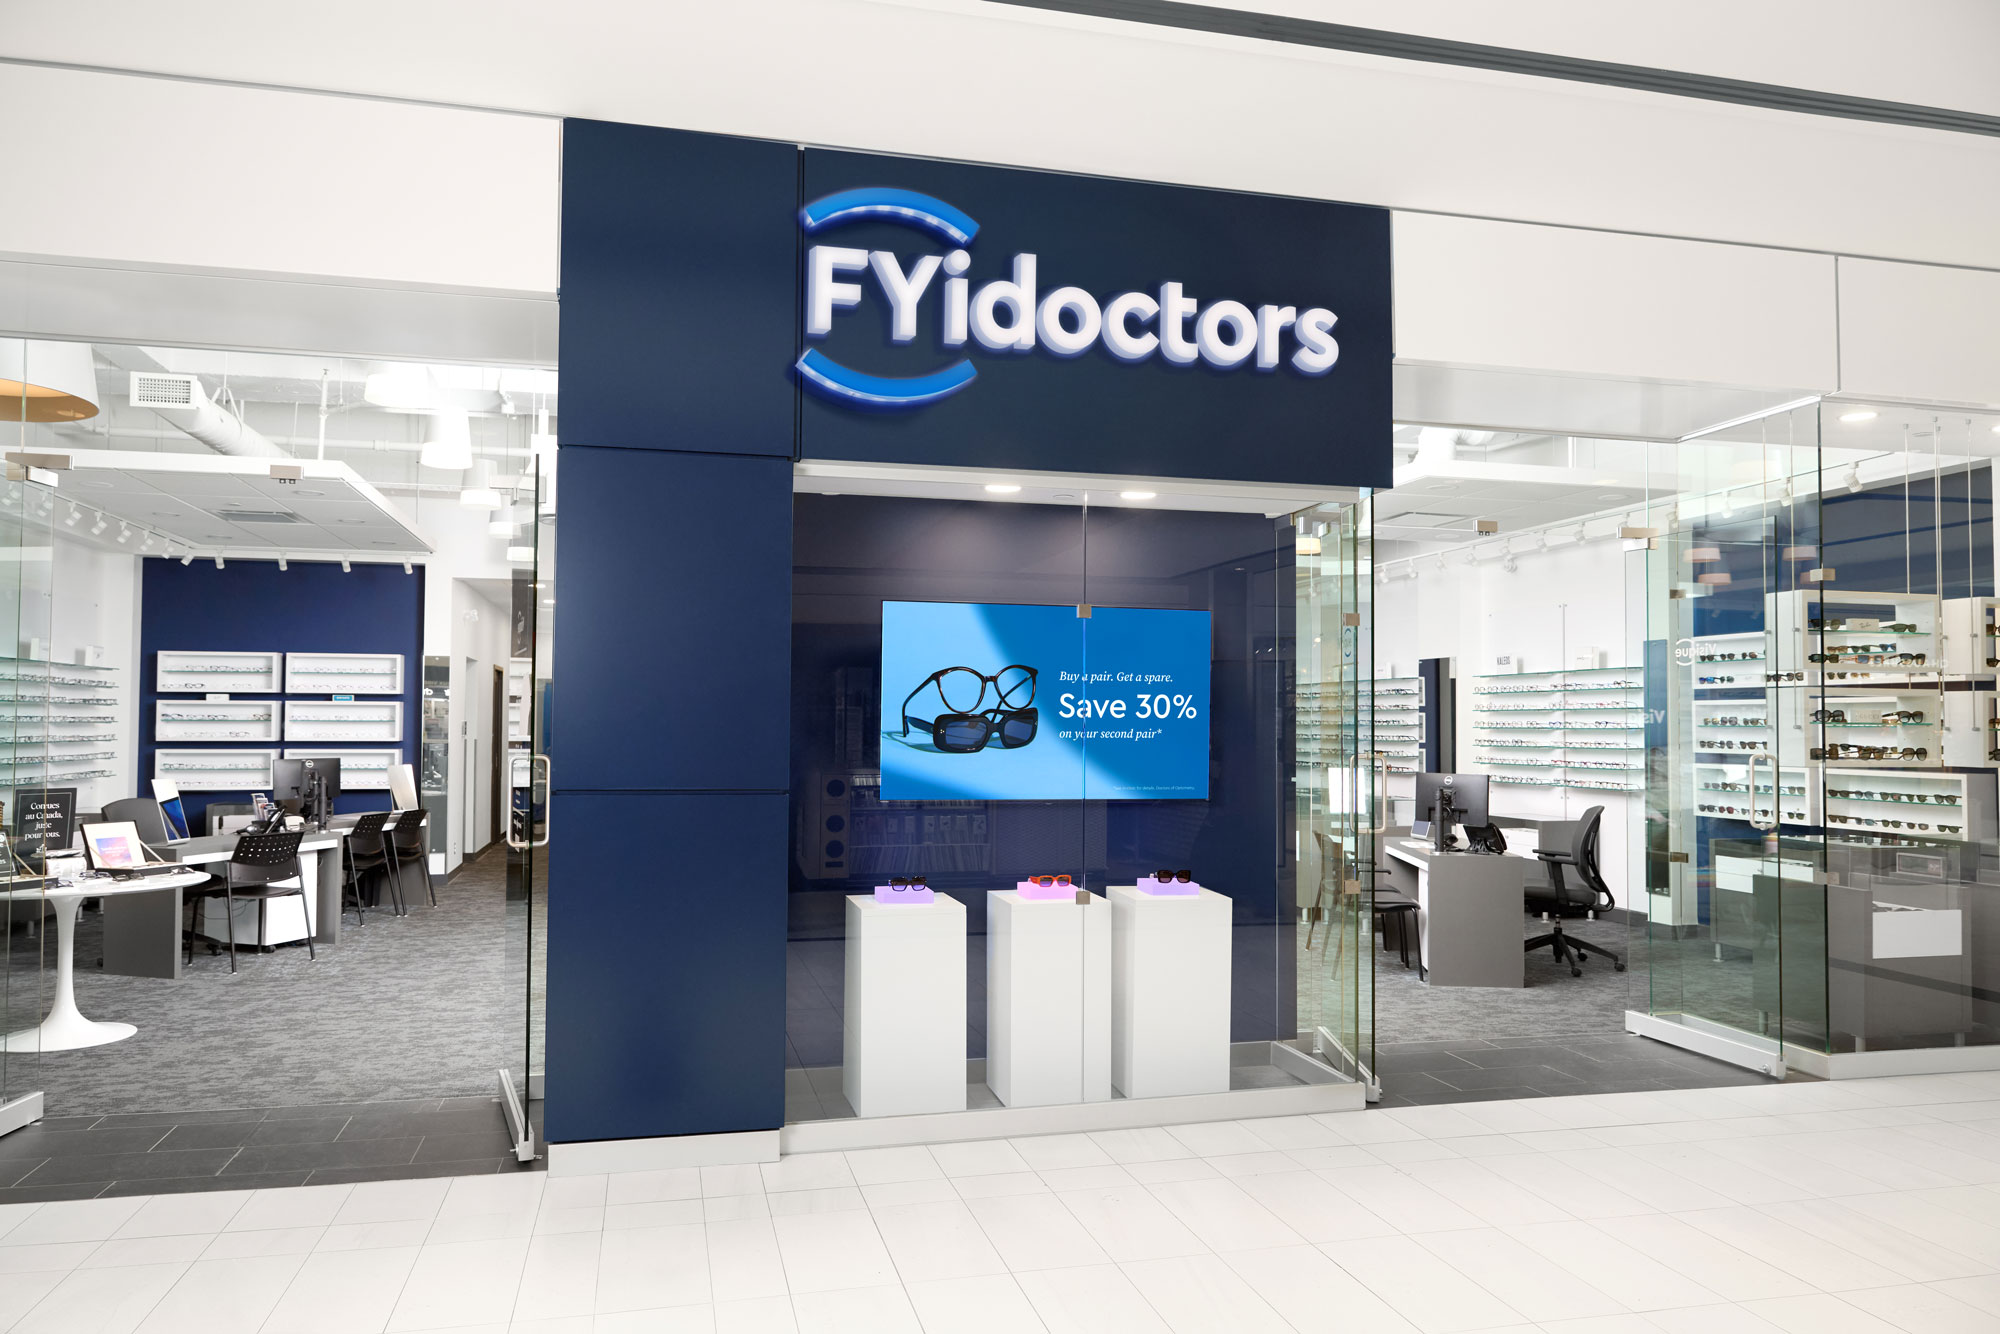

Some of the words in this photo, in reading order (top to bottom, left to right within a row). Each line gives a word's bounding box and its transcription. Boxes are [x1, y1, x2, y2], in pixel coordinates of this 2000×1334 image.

[806, 244, 1340, 374] FYidoctors
[1059, 671, 1079, 684] Buy
[1081, 673, 1088, 681] a
[1090, 671, 1113, 684] pair.
[1116, 671, 1133, 682] Get
[1135, 674, 1142, 682] a
[1144, 674, 1173, 684] spare.
[1059, 693, 1126, 719] Save
[1135, 693, 1197, 719] 30%
[1059, 730, 1072, 739] on
[1073, 730, 1098, 741] your
[1100, 728, 1133, 739] second
